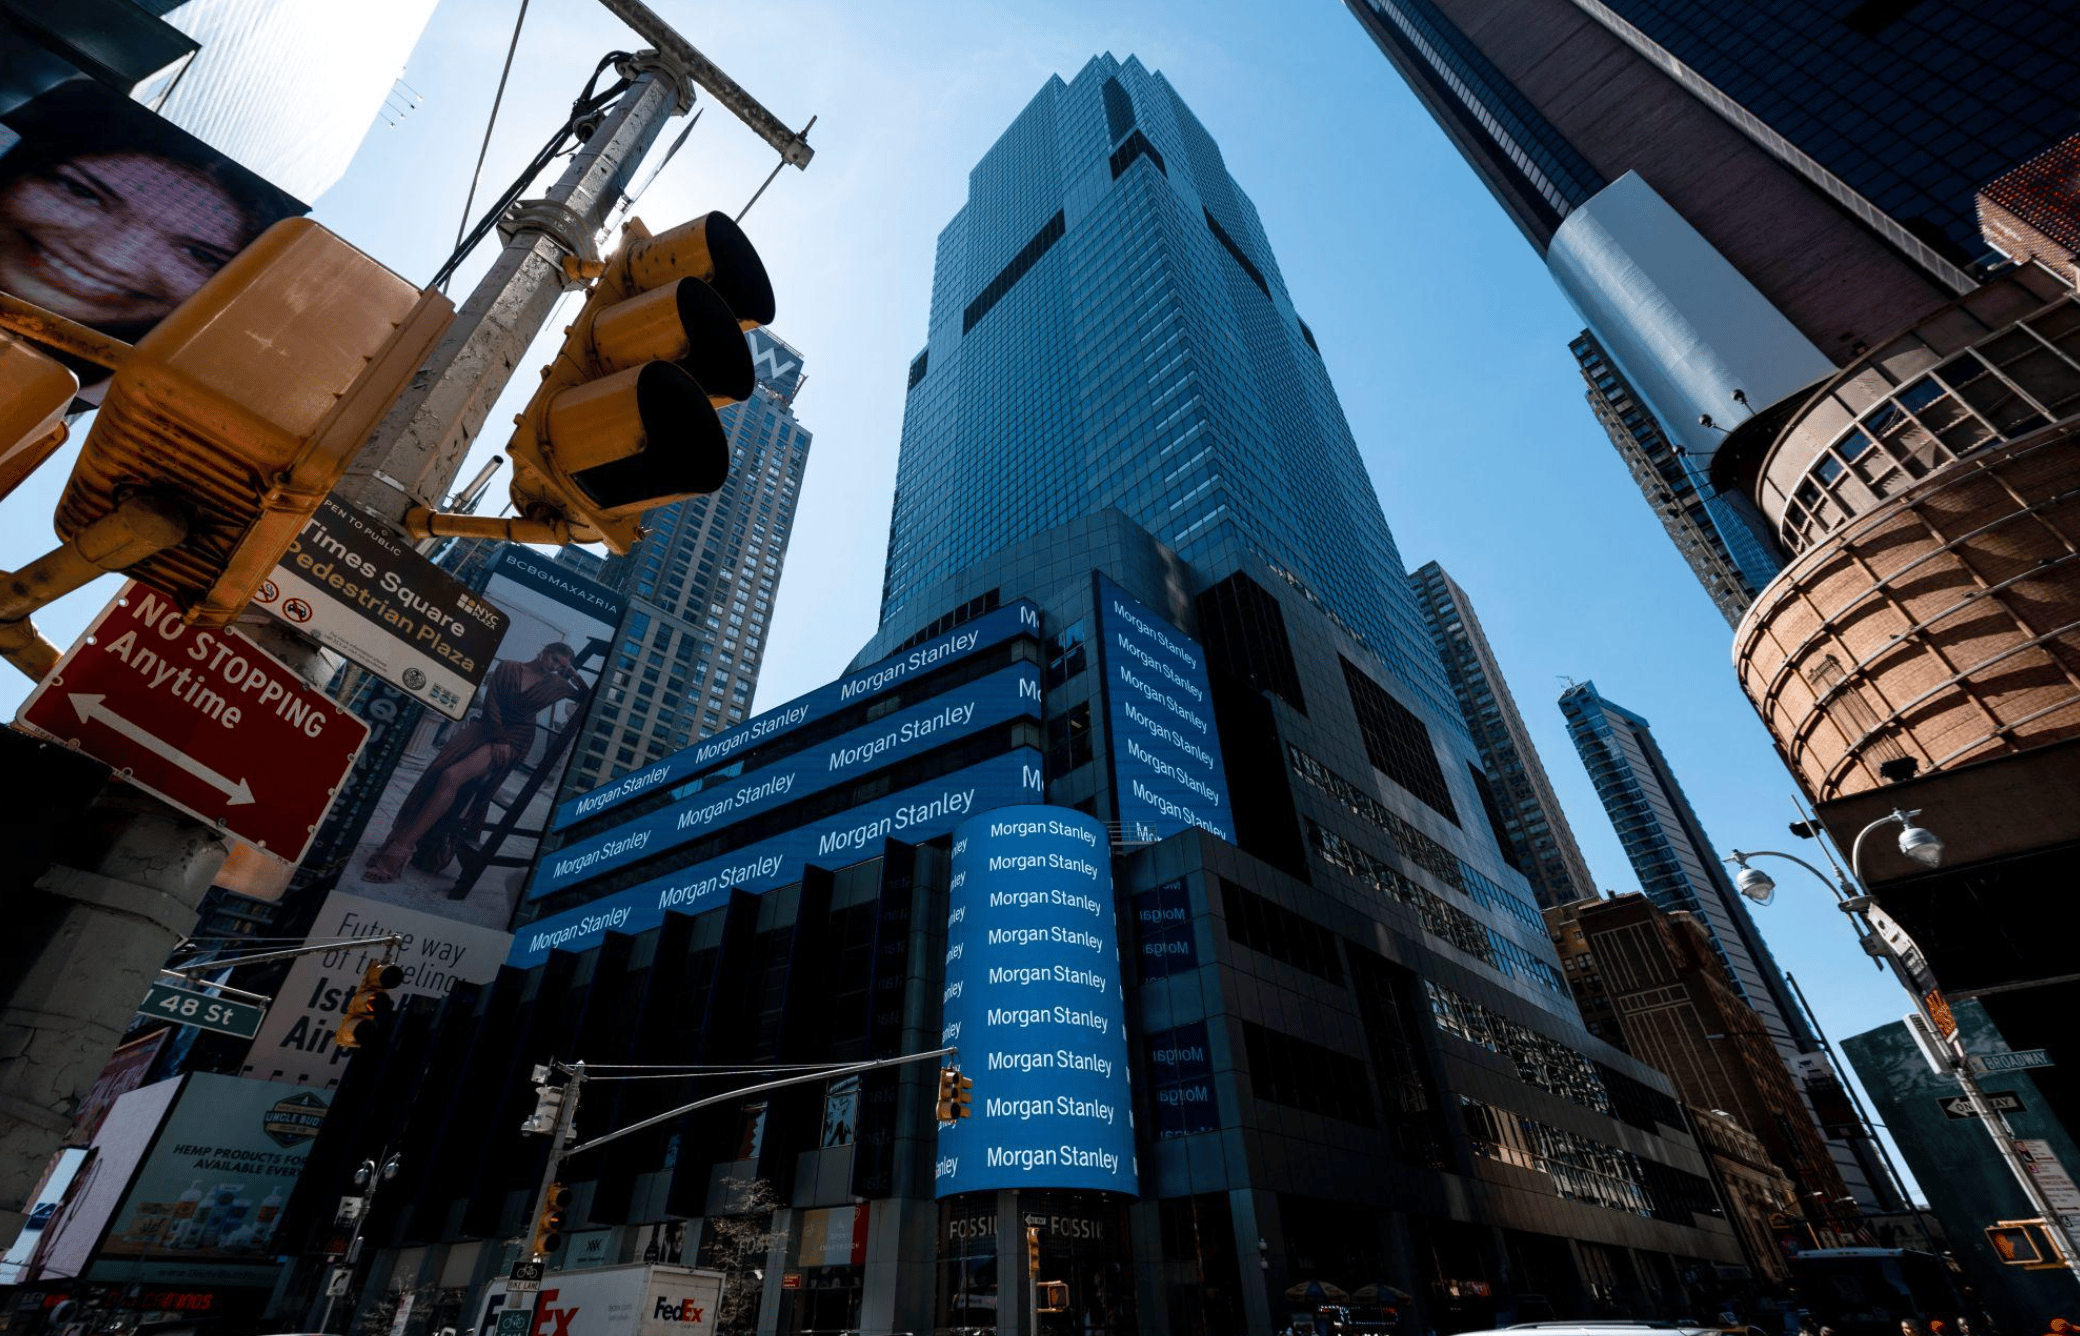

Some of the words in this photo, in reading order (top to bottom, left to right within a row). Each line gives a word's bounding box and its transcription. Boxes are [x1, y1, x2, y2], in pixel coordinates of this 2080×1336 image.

[324, 499, 348, 518] PEN
[349, 515, 363, 529] TO
[364, 527, 402, 556] PUBLIC
[301, 518, 377, 578] Times
[380, 571, 465, 637] Square
[506, 555, 617, 614] BCBGMAXAZRIA
[472, 611, 495, 630] PLAZA
[473, 604, 499, 626] NYC
[1114, 600, 1157, 640] Morgan
[1157, 631, 1197, 669] Stanley
[132, 592, 186, 641] NO
[187, 632, 327, 738] STOPPING
[416, 624, 475, 673] Plaza
[841, 662, 905, 700] Morgan
[908, 630, 979, 671] Stanley
[1118, 633, 1162, 674] Morgan
[1162, 664, 1203, 702] Stanley
[104, 630, 242, 729] Anytime
[1120, 665, 1166, 706] Morgan
[1166, 696, 1207, 734] Stanley
[696, 731, 749, 764] Morgan
[750, 704, 809, 743] Stanley
[829, 732, 897, 771] Morgan
[900, 702, 975, 742] Stanley
[1125, 702, 1171, 742] Morgan
[1171, 732, 1214, 769] Stanley
[576, 784, 622, 816] Morgan
[622, 765, 671, 797] Stanley
[1127, 738, 1176, 780] Morgan
[1176, 767, 1219, 806] Stanley
[677, 797, 733, 831] Morgan
[734, 772, 796, 808] Stanley
[819, 817, 891, 856] Morgan
[895, 788, 975, 830] Stanley
[1133, 779, 1182, 820] Morgan
[553, 849, 601, 879] Morgan
[600, 829, 652, 861] Stanley
[991, 822, 1046, 838] Morgan
[1049, 821, 1097, 847] Stanley
[658, 875, 717, 910] Morgan
[718, 854, 783, 889] Stanley
[989, 855, 1046, 871] Morgan
[1049, 854, 1098, 880] Stanley
[990, 891, 1049, 908] Morgan
[1051, 890, 1101, 917] Stanley
[337, 912, 414, 951] Fute
[421, 938, 466, 968] way
[529, 926, 578, 953] Morgan
[577, 906, 632, 944] Stanley
[988, 928, 1048, 945] Morgan
[1051, 927, 1103, 953] Stanley
[323, 948, 351, 970] of
[989, 967, 1050, 985] Morgan
[1054, 965, 1106, 993] Stanley
[159, 995, 199, 1016] 48
[204, 1004, 234, 1025] St
[987, 1008, 1050, 1027] Morgan
[1054, 1006, 1108, 1034] Stanley
[988, 1051, 1053, 1072] Morgan
[1057, 1050, 1112, 1078] Stanley
[1984, 1052, 2048, 1070] BROADWAY
[265, 1112, 297, 1123] UNCLE
[986, 1098, 1053, 1120] Morgan
[1057, 1096, 1114, 1125] Stanley
[1956, 1100, 1973, 1112] ON
[173, 1144, 212, 1156] HEMP
[213, 1148, 282, 1162] PRODUCTS
[193, 1159, 264, 1174] AVAILABLE
[987, 1147, 1056, 1170] Morgan
[1060, 1145, 1118, 1174] Stanley
[523, 1281, 540, 1289] LANE
[479, 1289, 579, 1336] FEx
[654, 1296, 704, 1322] FedEx
